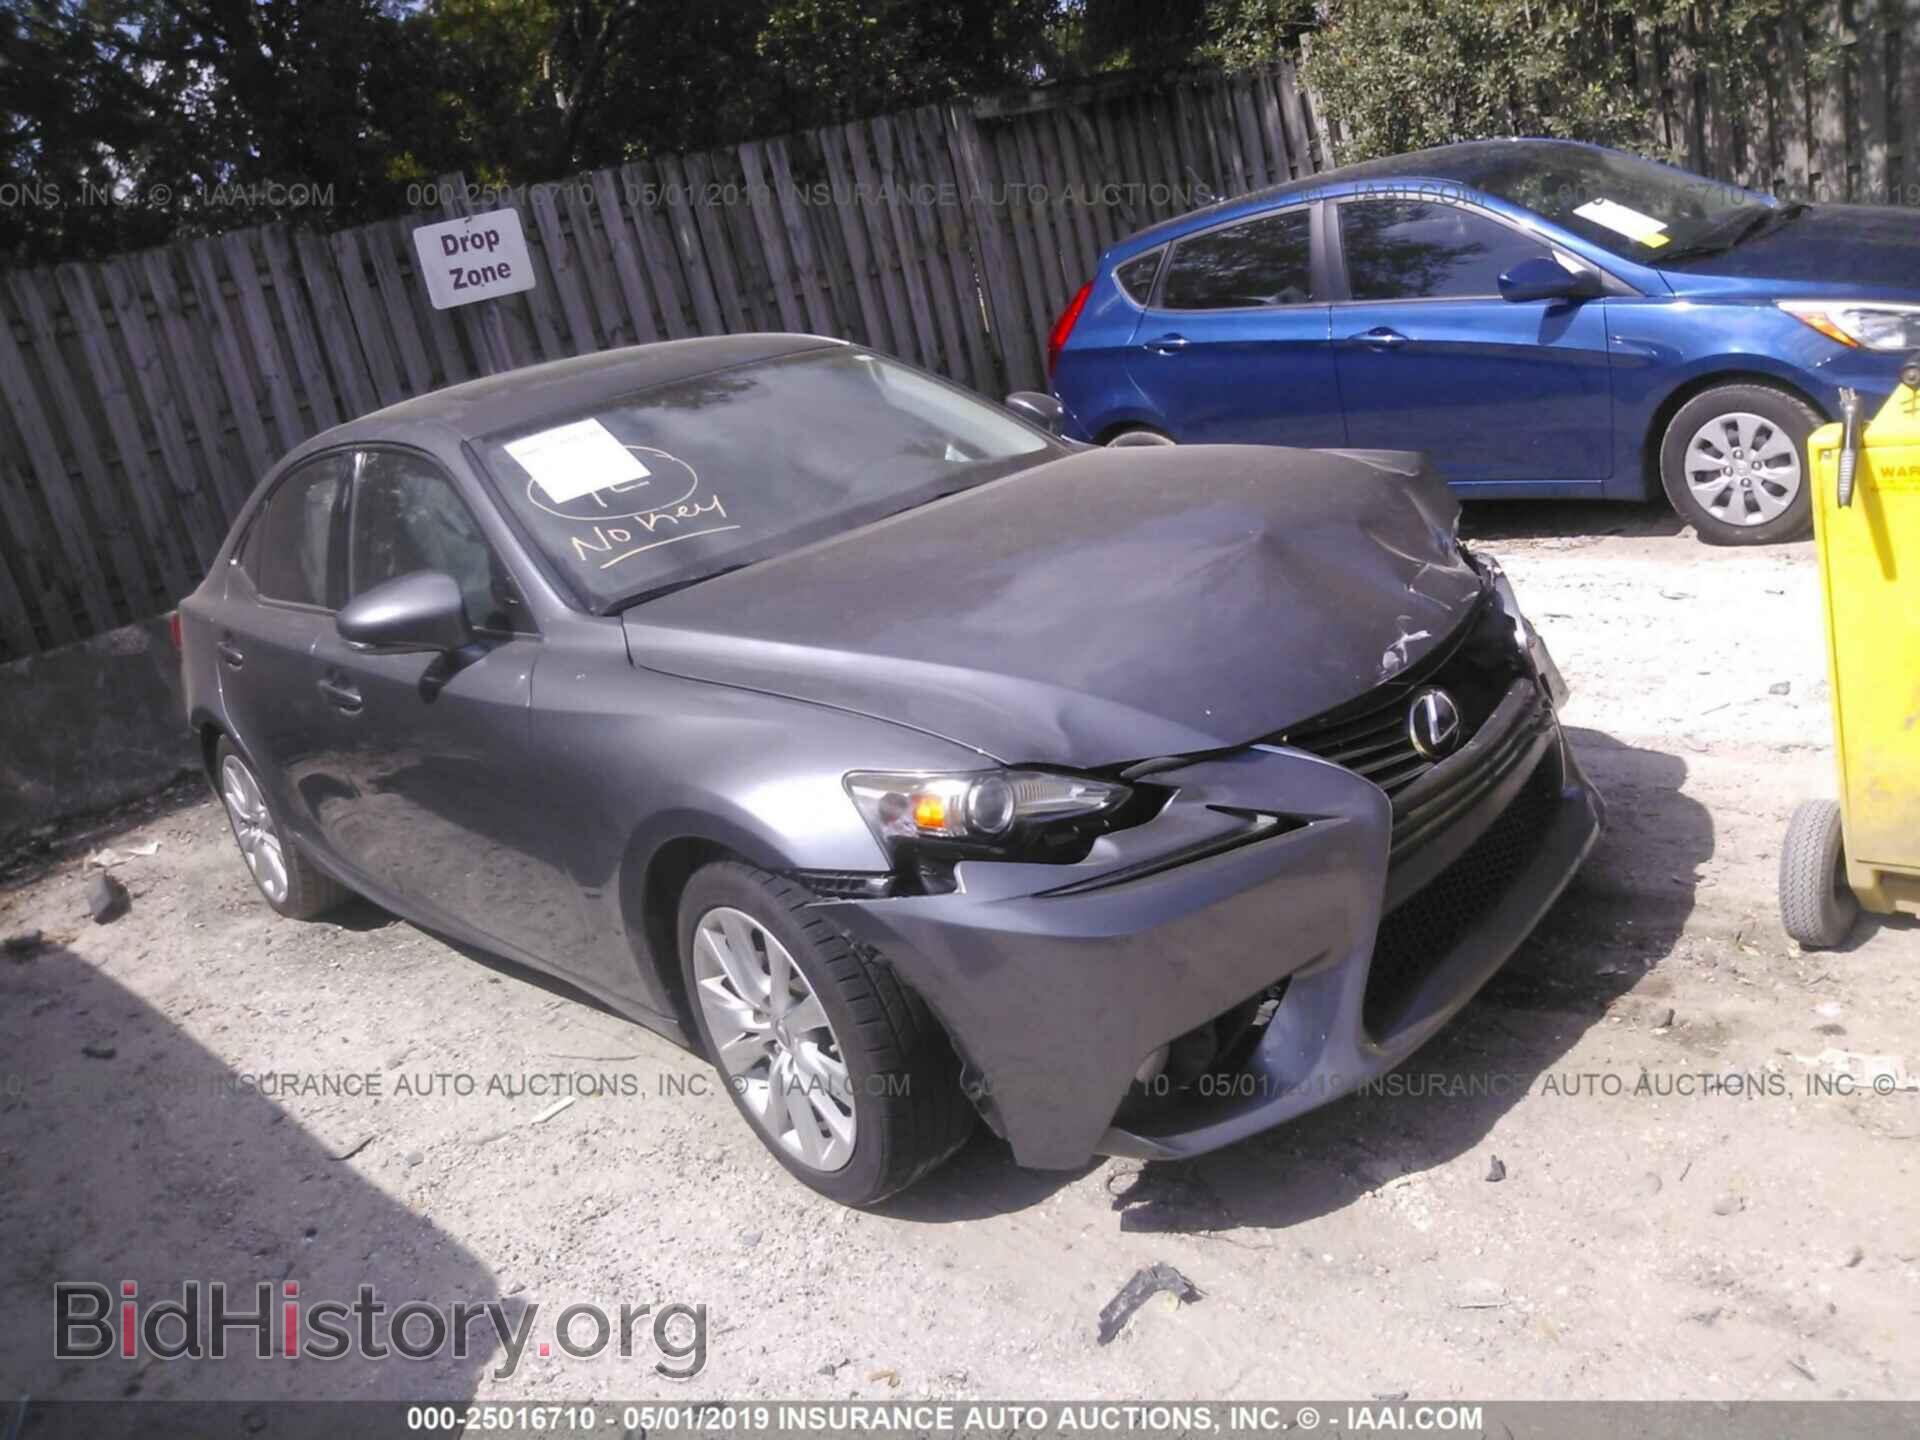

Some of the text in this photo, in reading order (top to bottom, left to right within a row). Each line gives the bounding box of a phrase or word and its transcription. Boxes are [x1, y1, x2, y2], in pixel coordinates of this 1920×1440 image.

[441, 229, 500, 256] Drop
[449, 262, 511, 290] Zone
[570, 526, 631, 561] No
